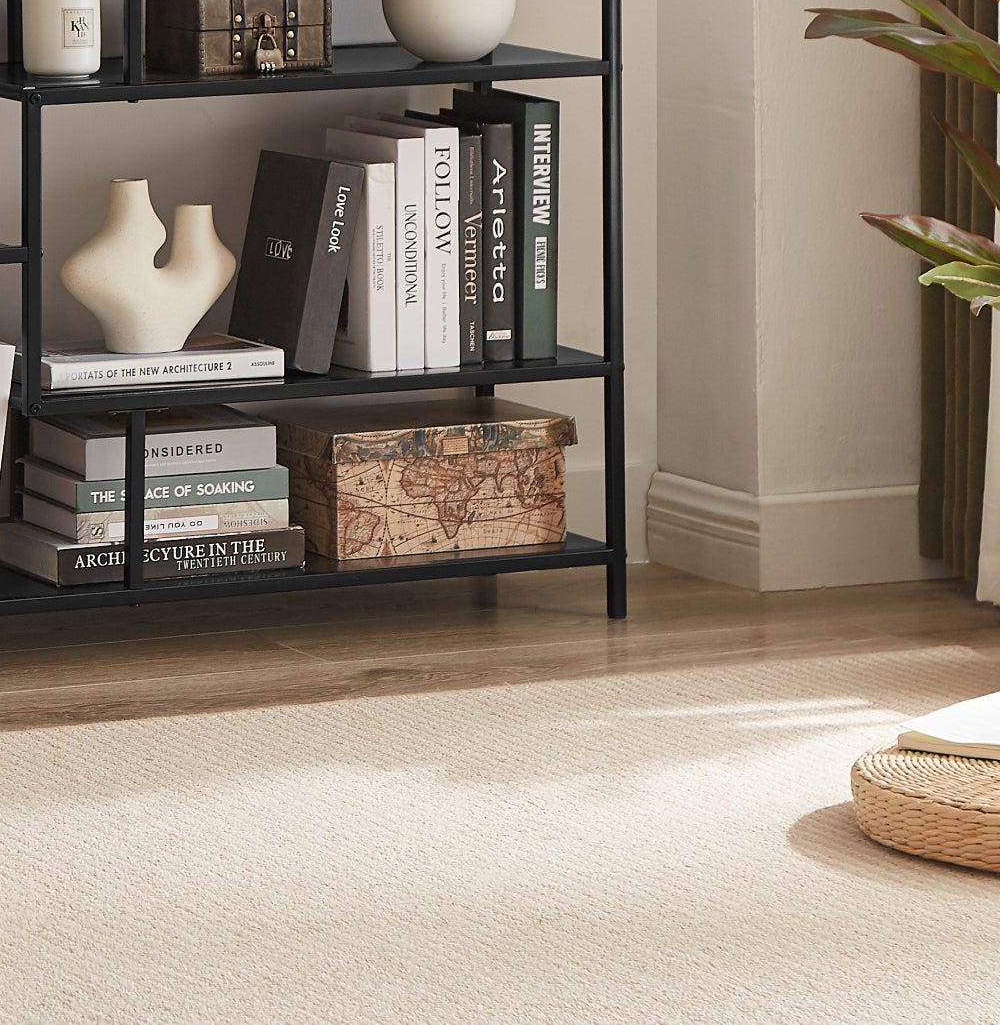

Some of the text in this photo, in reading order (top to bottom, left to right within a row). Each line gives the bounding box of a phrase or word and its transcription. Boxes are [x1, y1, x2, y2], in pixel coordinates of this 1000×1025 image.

[533, 123, 551, 225] INTERVIEW
[434, 146, 452, 255] FOLLOW
[328, 185, 351, 253] Love Look
[376, 225, 384, 292] STILETTO BOOK
[404, 204, 418, 308] UNCONDITIONAL
[464, 211, 482, 305] Vermeer
[107, 368, 121, 379] OF
[122, 367, 137, 378] THE
[139, 365, 160, 376] NEW
[162, 362, 224, 375] ARCHITECTURE
[226, 362, 232, 371] 2
[144, 443, 223, 459] ONSIDERED
[90, 490, 115, 504] THE
[175, 485, 191, 498] OF
[196, 480, 255, 497] SOAKING
[145, 523, 165, 531] LIKE
[223, 518, 268, 528] SIDESHOW
[74, 539, 265, 569] ARCHIECYURE IN THE
[177, 551, 288, 571] TWENTIETH CENTURY
